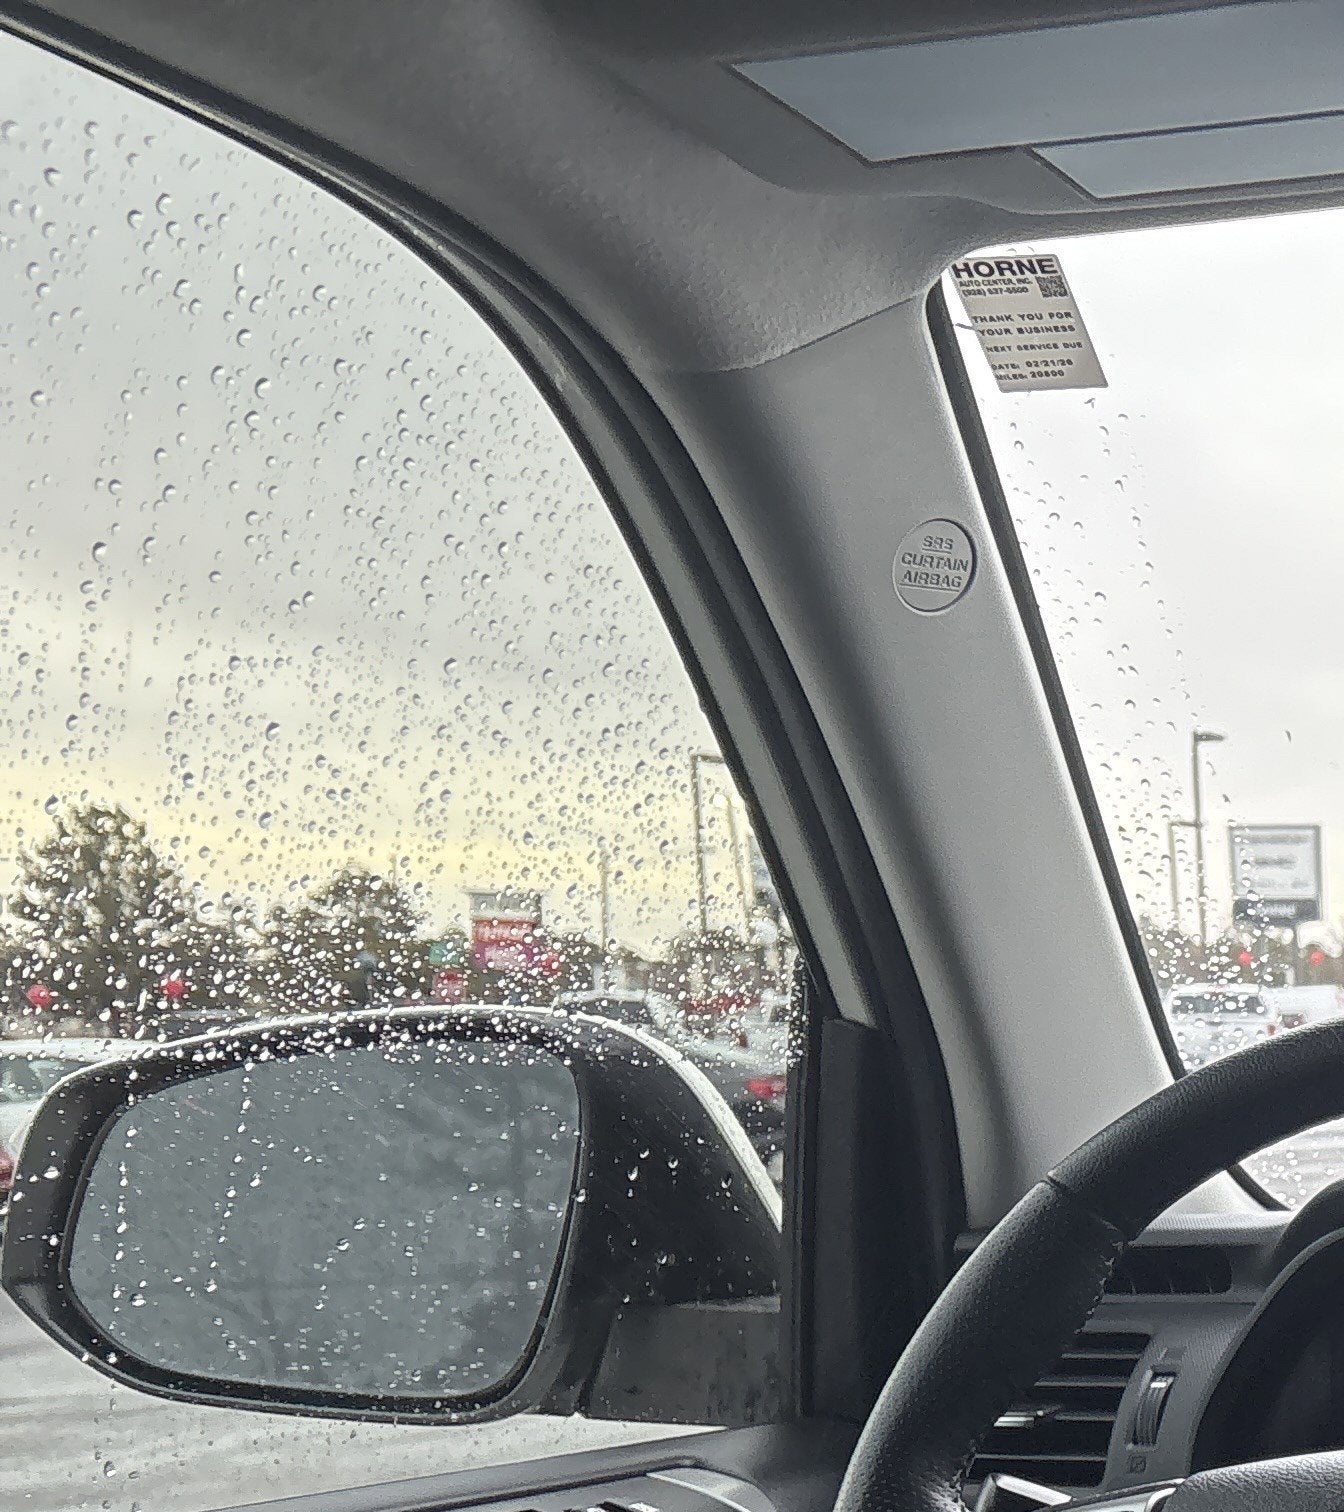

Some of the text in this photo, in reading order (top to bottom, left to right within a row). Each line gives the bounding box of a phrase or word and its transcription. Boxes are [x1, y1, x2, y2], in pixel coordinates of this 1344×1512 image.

[951, 258, 1058, 278] HORNE
[972, 311, 1073, 323] THANK YOU FOR
[978, 325, 1075, 336] YOUR BUSINESS
[1017, 343, 1059, 351] SERVICE
[901, 552, 969, 572] CURTAIN
[903, 569, 963, 588] AIRBAG
